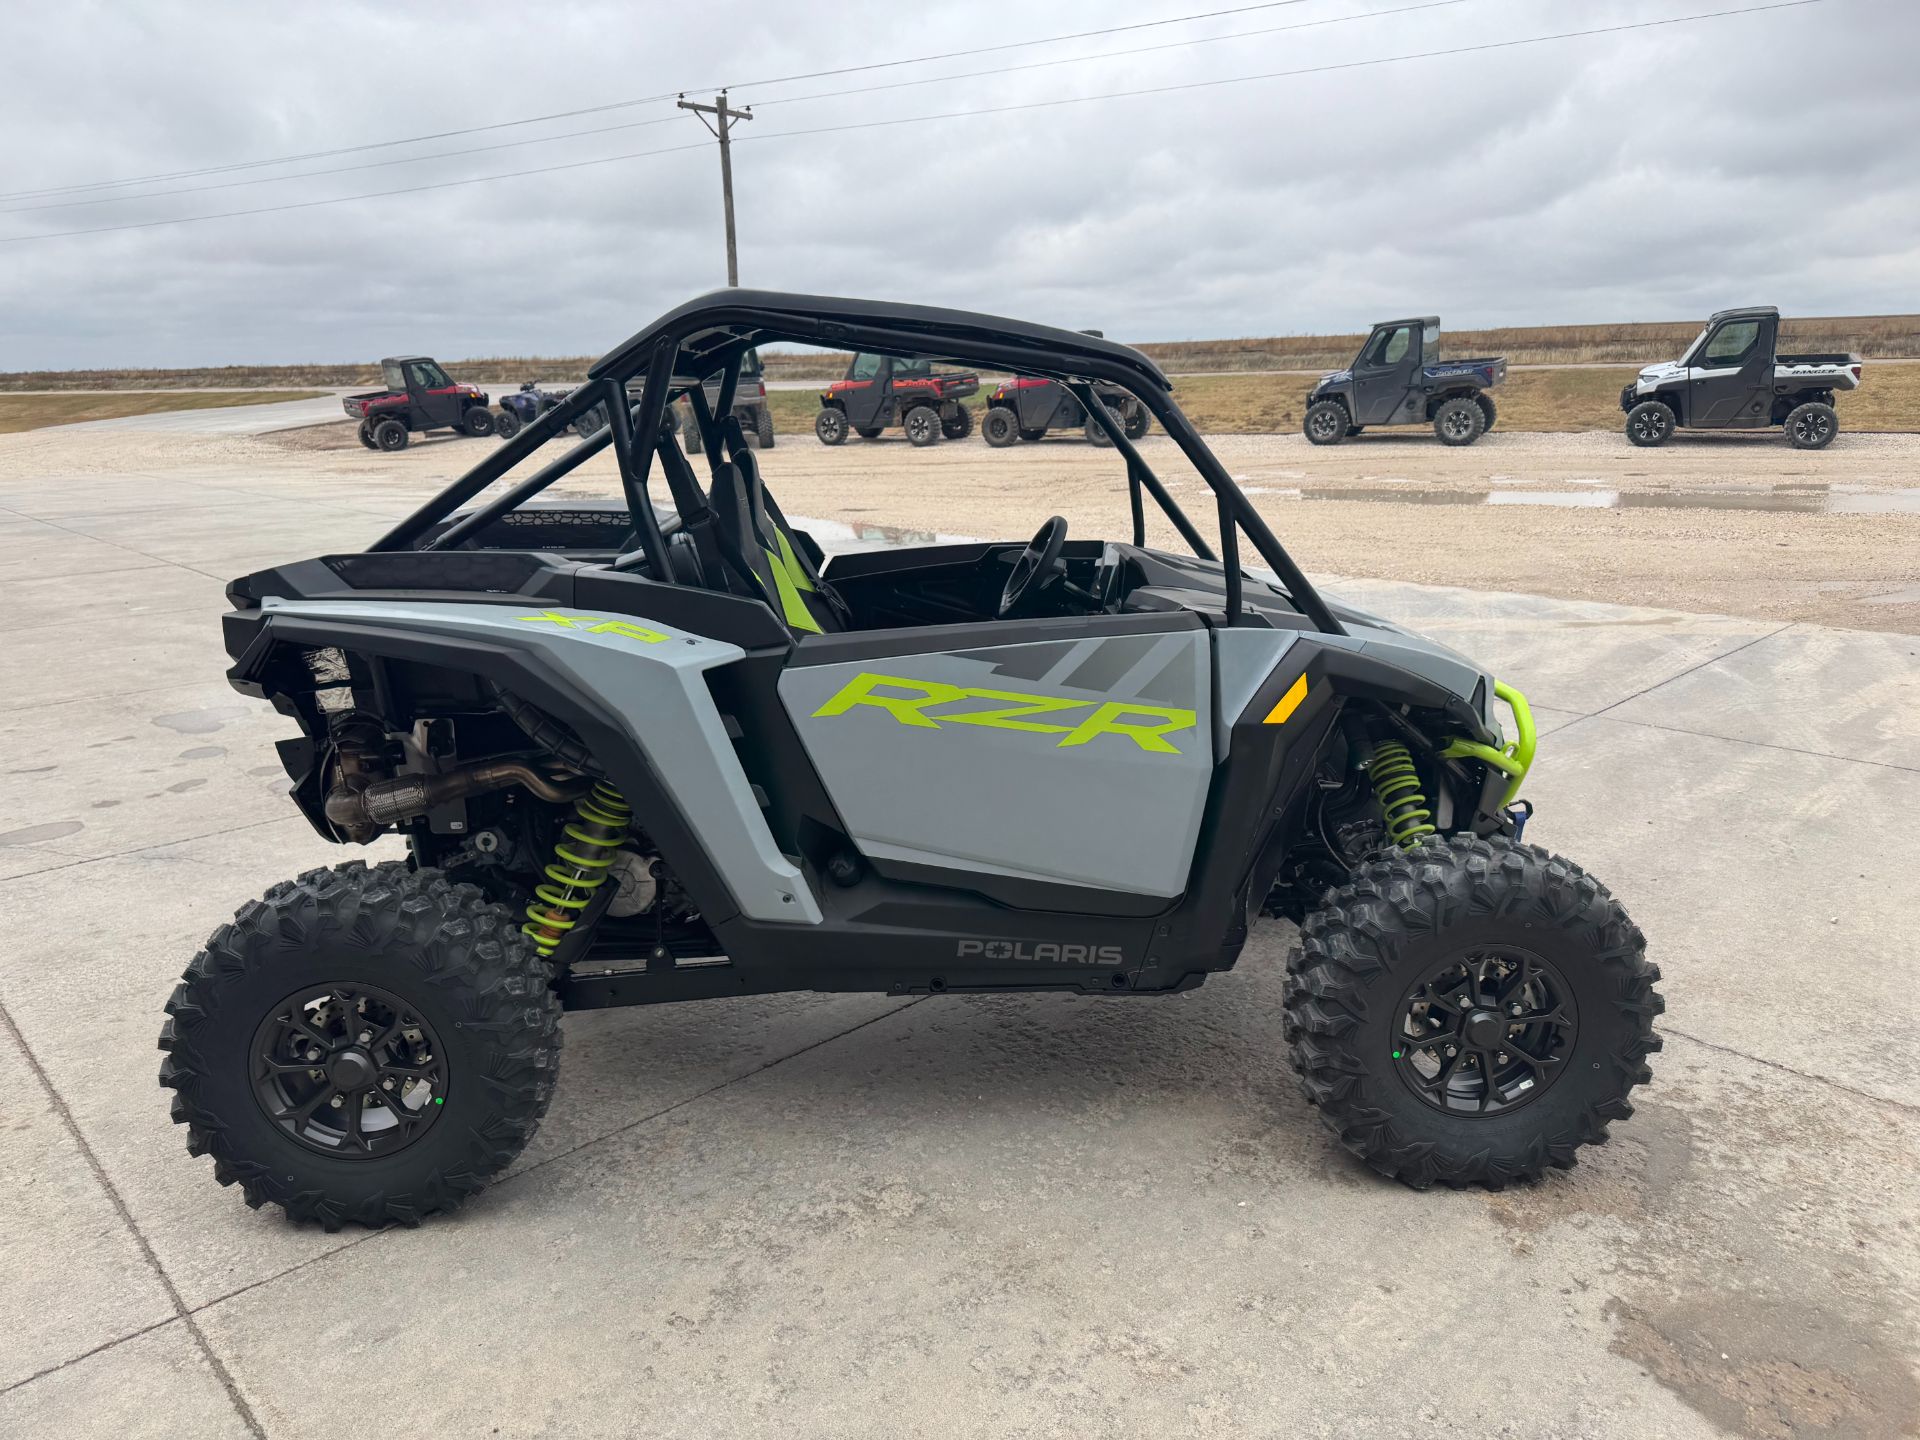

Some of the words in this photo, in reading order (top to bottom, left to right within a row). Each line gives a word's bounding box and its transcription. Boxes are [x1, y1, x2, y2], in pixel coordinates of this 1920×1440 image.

[515, 610, 672, 644] XP
[811, 672, 1197, 754] RZR
[957, 940, 1123, 965] POLARIS
